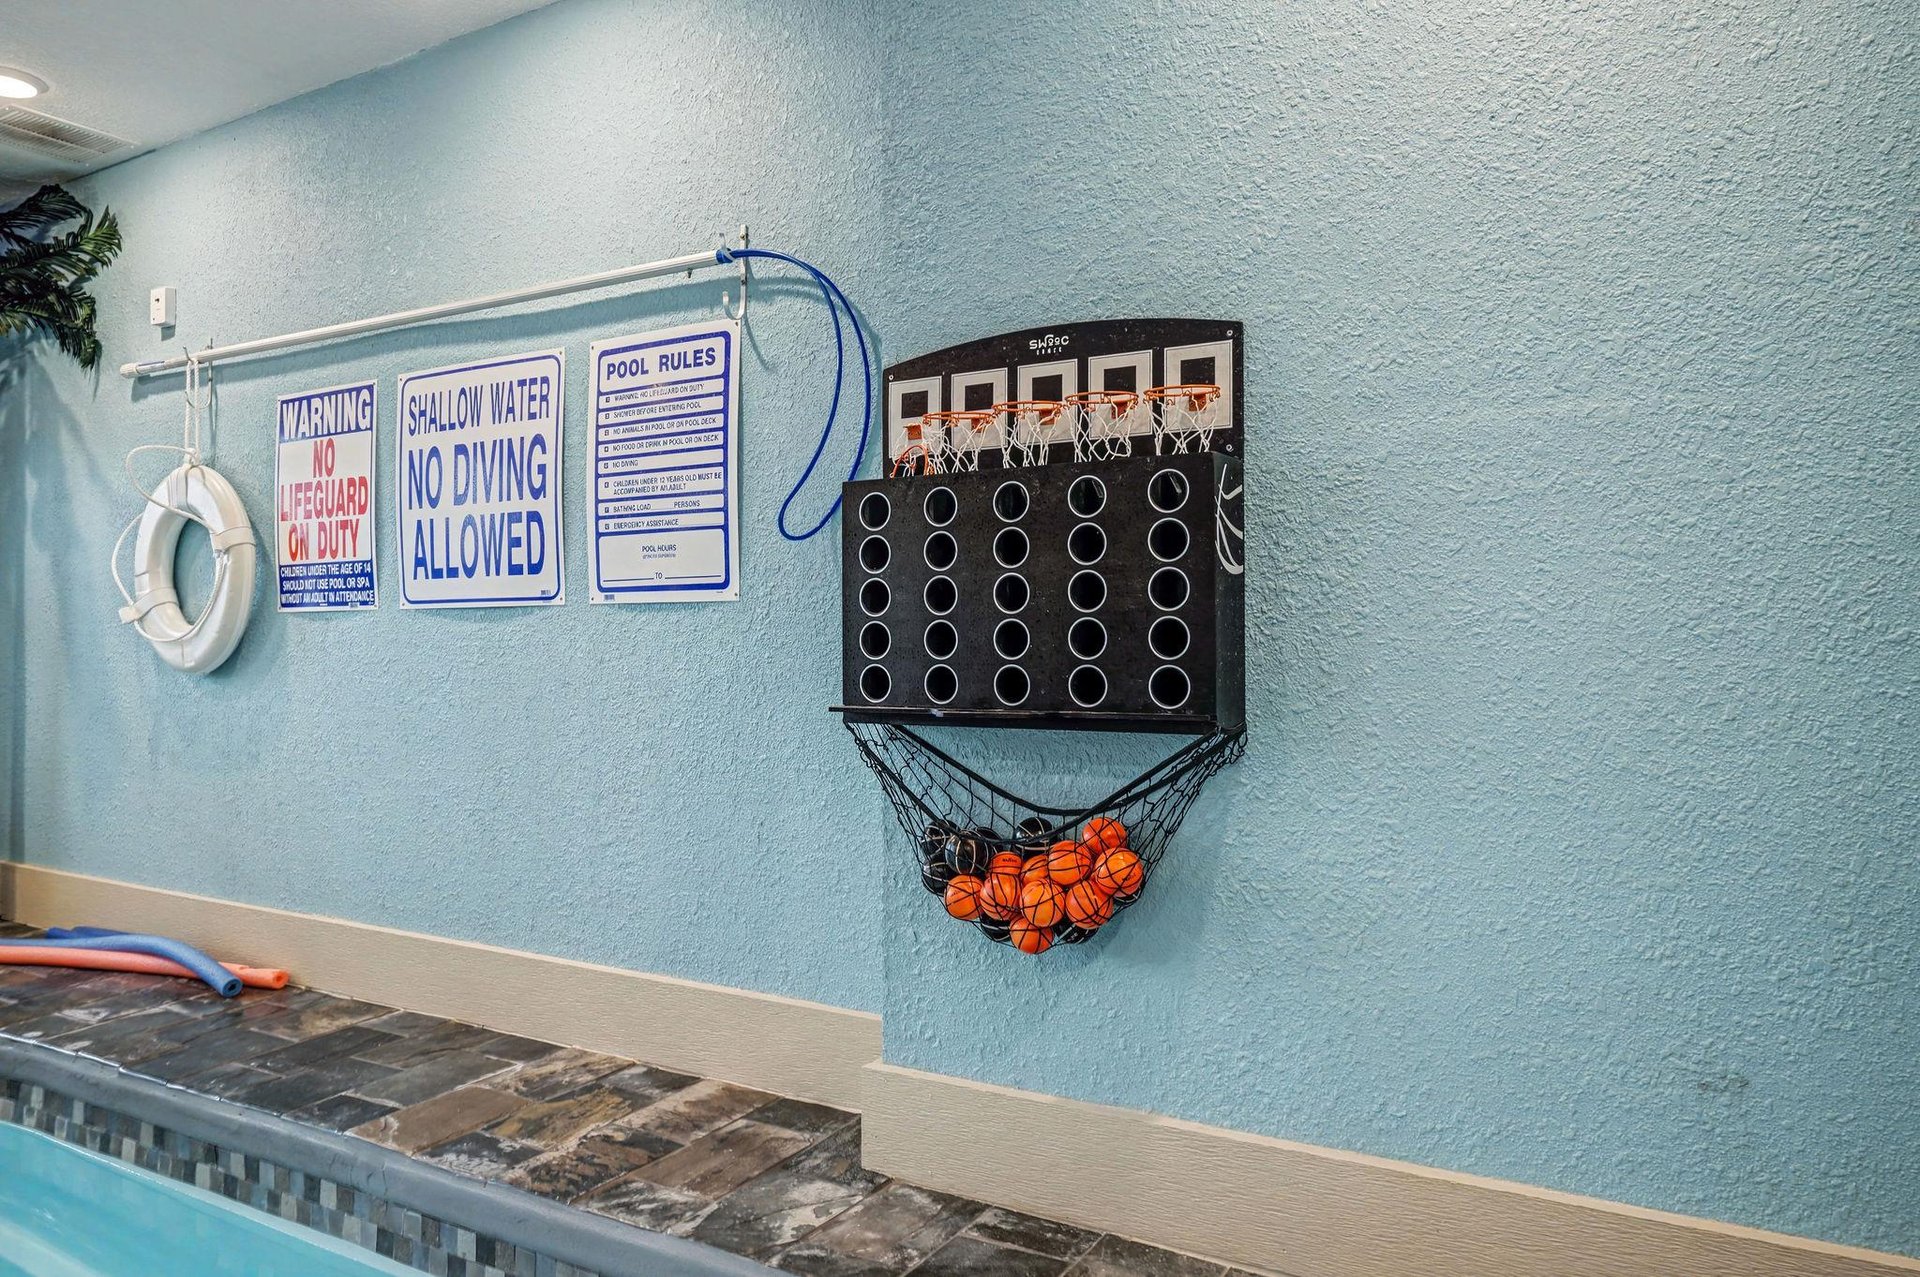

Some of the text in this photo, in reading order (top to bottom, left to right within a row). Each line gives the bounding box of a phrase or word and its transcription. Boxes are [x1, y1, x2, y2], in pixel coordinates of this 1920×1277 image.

[1029, 334, 1070, 350] SWOOC
[607, 347, 716, 380] POOL RULES
[649, 387, 679, 397] LIFEGUARD
[690, 384, 704, 392] DUTY
[282, 388, 371, 440] WARNING
[408, 376, 551, 437] SHALLOW WATER
[614, 410, 635, 418] SHOWER
[637, 407, 657, 416] BEFORE
[659, 404, 685, 413] ENTERING
[622, 425, 644, 434] ANIMALS
[652, 423, 665, 431] POOL
[685, 419, 700, 427] POOL
[669, 438, 683, 446] POOL
[703, 434, 718, 442] DECK
[314, 438, 336, 478] NO
[408, 434, 547, 510] NO DIVING
[613, 479, 639, 488] CHILDREN
[614, 486, 650, 495] ACCOMPANIED
[280, 476, 368, 522] LIFEGUARD
[674, 500, 700, 508] PERSONS
[614, 519, 679, 529] EMERGENCY ASSISTANCE
[288, 518, 360, 562] ON DUTY
[414, 510, 545, 580] ALLOWED
[281, 562, 371, 577] CHILDREN UNDER THE AGE OF 14
[656, 572, 663, 580] TO
[283, 577, 369, 591] SHOULD NOT USE POOL OR SPA
[281, 590, 374, 604] WITHOUT AN ADULT IN ATTENDANCE
